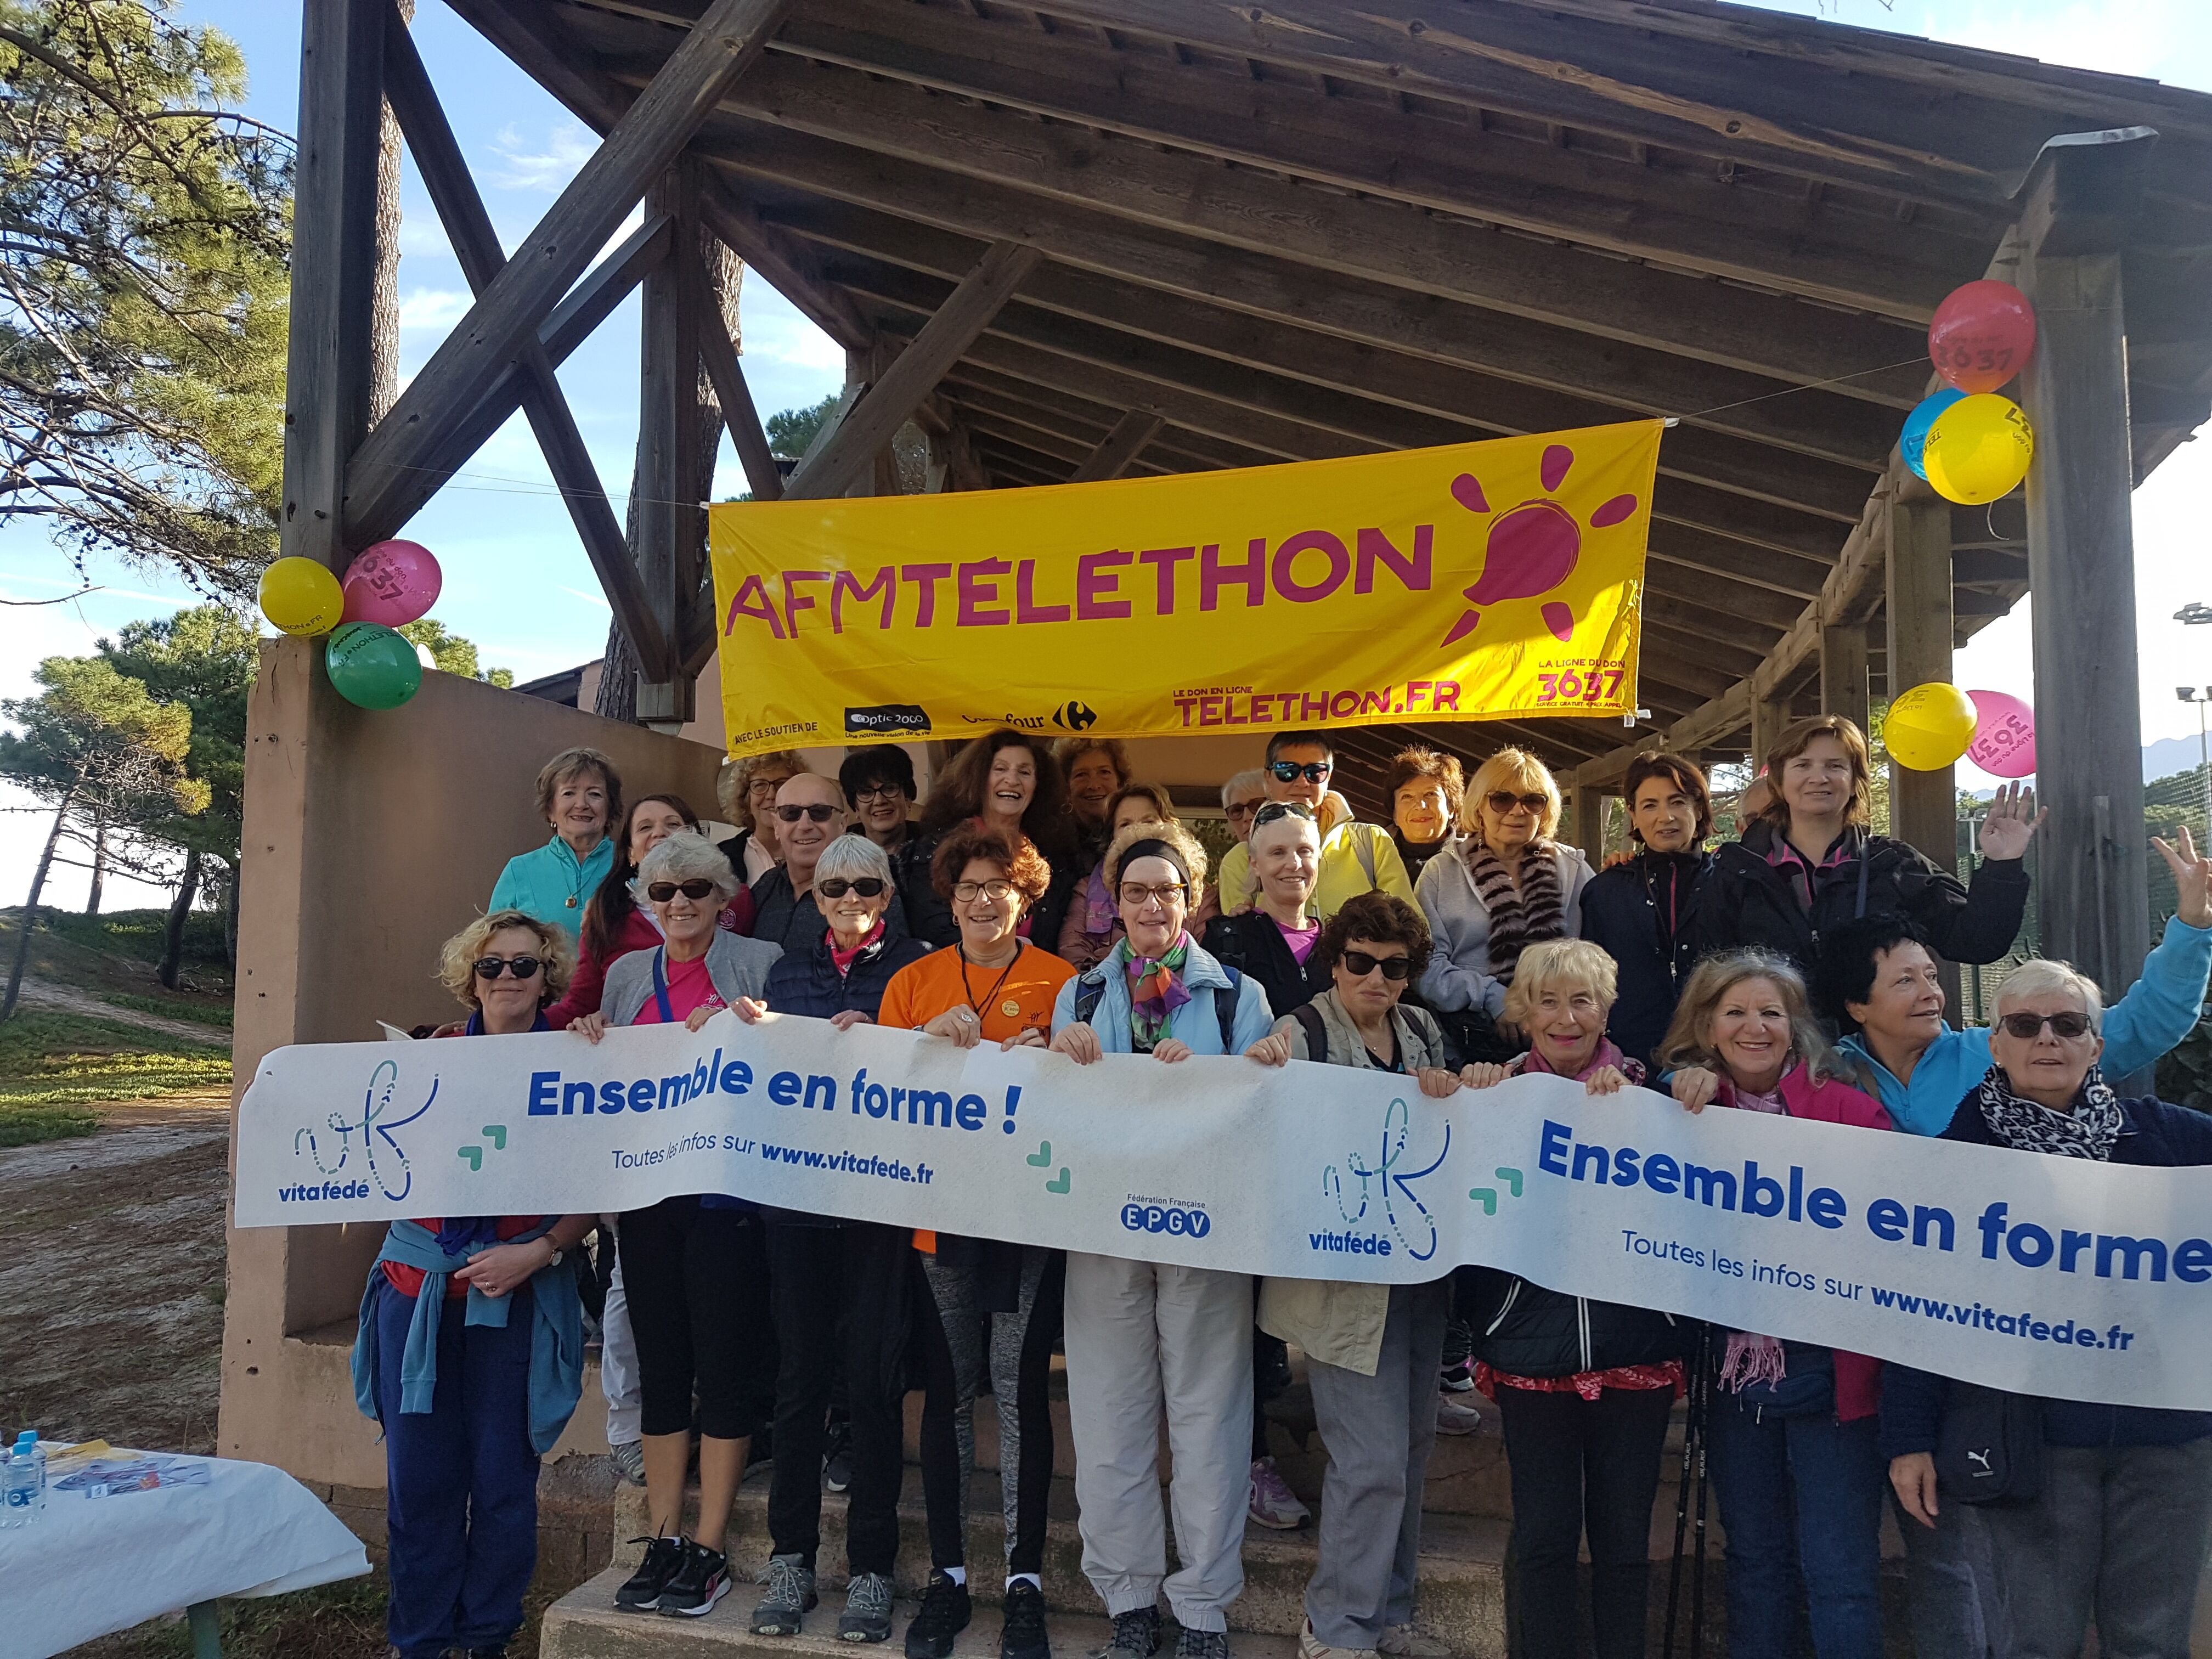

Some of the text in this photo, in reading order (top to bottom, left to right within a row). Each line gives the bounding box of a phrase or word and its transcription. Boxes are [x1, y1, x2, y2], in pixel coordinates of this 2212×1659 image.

[1556, 659, 1585, 668] LIGNE
[1188, 688, 1208, 696] DON
[1226, 686, 1253, 694] LIGNE
[1537, 669, 1624, 702] 3637
[735, 722, 818, 744] AVEC LE SOUTIEN DE
[857, 713, 923, 726] Optic 2000
[527, 1047, 1023, 1135] Ensemble en forme !
[611, 1130, 934, 1184] Toutes les infos sur www.vitafede.fr
[279, 1180, 370, 1203] vitafédé
[1127, 1194, 1206, 1208] Fédération Française
[1538, 1118, 2212, 1283] Ensemble en forme
[1126, 1206, 1205, 1234] EPGV
[1310, 1229, 1392, 1257] vitafédé
[1621, 1229, 2135, 1352] Toutes les infos sur www.vitafede.fr
